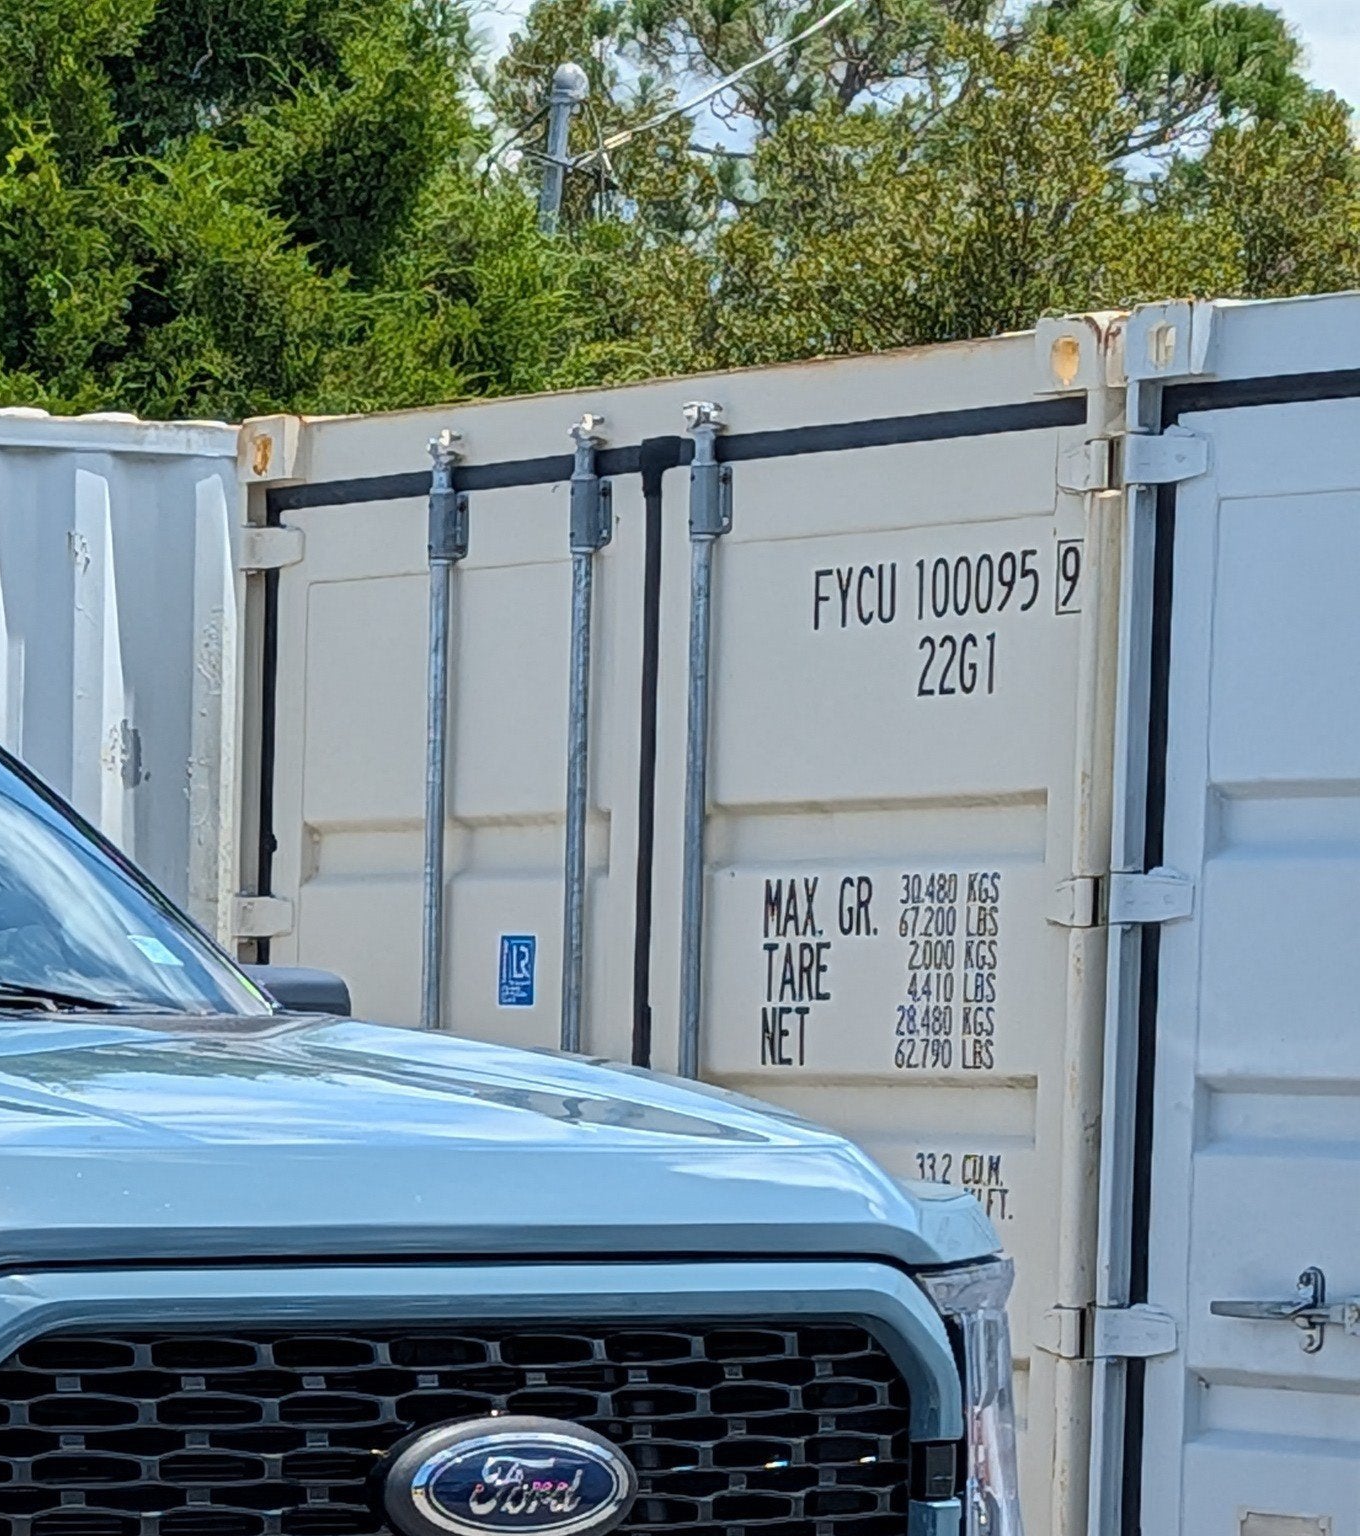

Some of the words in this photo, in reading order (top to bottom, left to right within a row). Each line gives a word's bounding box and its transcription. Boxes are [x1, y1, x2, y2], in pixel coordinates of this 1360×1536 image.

[813, 562, 897, 630] FYCU
[915, 549, 1040, 620] 100095
[1060, 546, 1081, 607] 9
[916, 631, 997, 697] 22G1
[763, 876, 824, 938] MAX.
[838, 875, 879, 936] GR.
[965, 872, 1001, 904] KGS
[965, 905, 999, 937] LBS
[762, 941, 832, 1002] TARE
[964, 940, 998, 970] KGS
[963, 972, 997, 1003] LBS
[760, 1006, 810, 1066] NET
[961, 1006, 996, 1037] KGS
[961, 1038, 995, 1069] LBS
[468, 1456, 590, 1515] Ford
